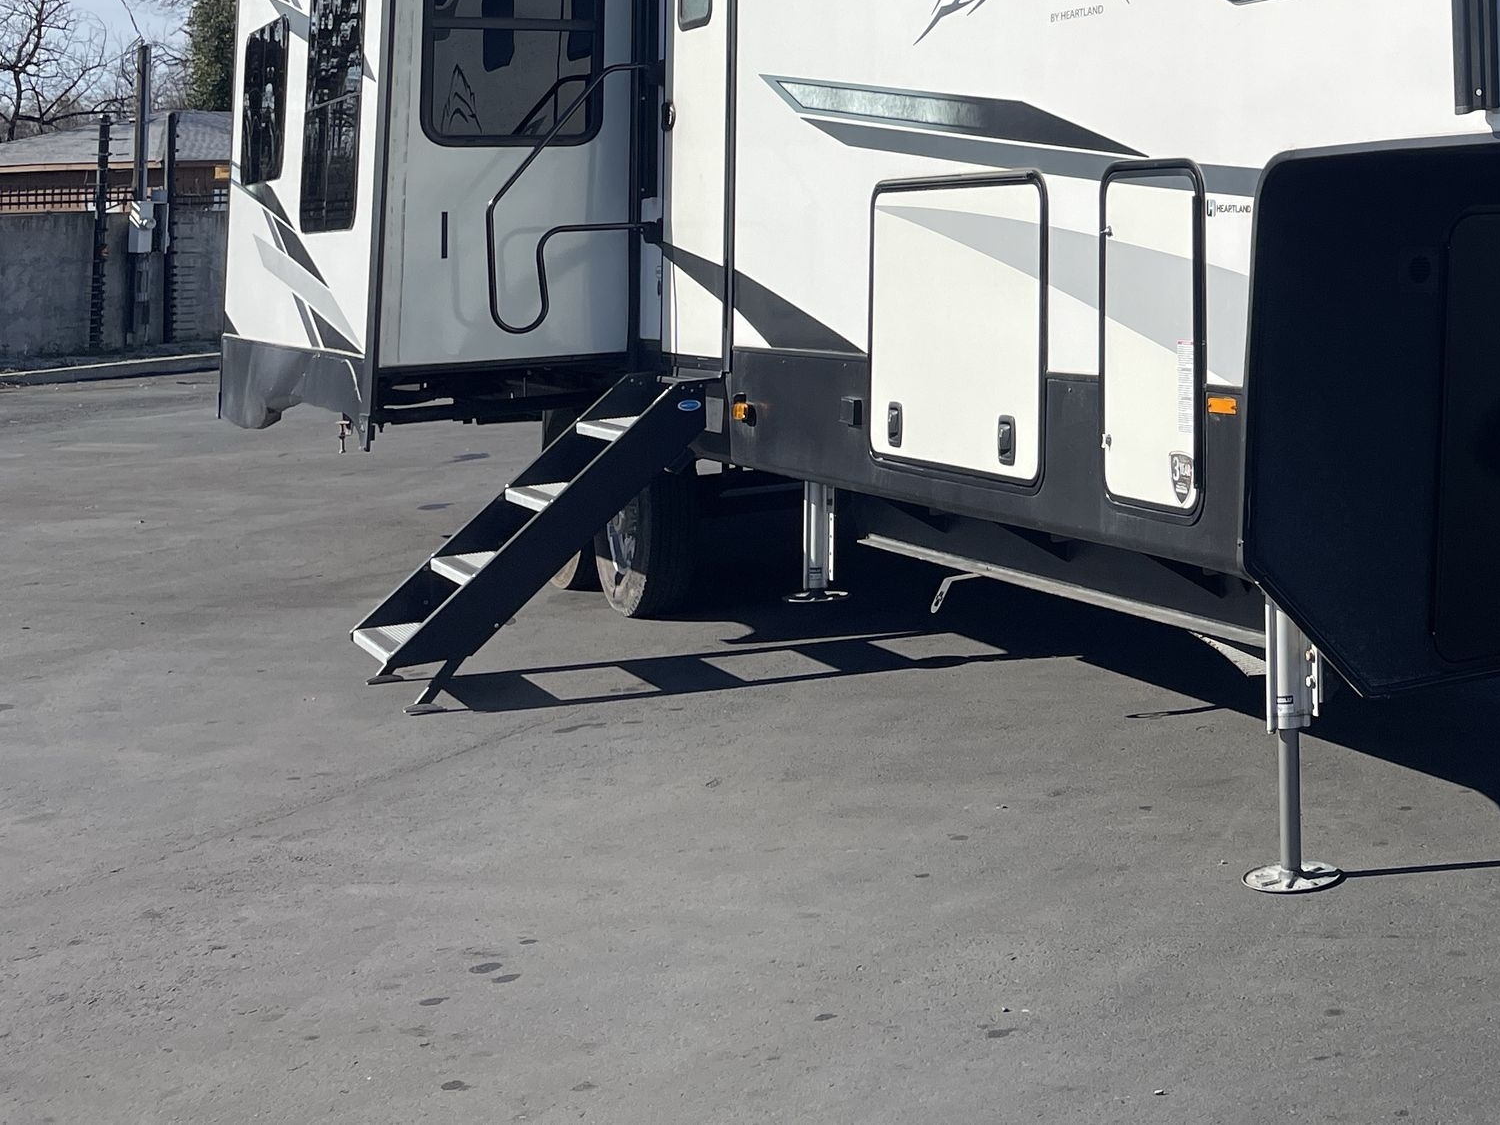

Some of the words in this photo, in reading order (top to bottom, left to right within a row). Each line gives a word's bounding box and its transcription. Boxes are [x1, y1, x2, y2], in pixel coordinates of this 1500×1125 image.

[1050, 13, 1059, 22] BY
[1060, 5, 1104, 20] HEARTLAND
[1217, 204, 1251, 213] HEARTLAND
